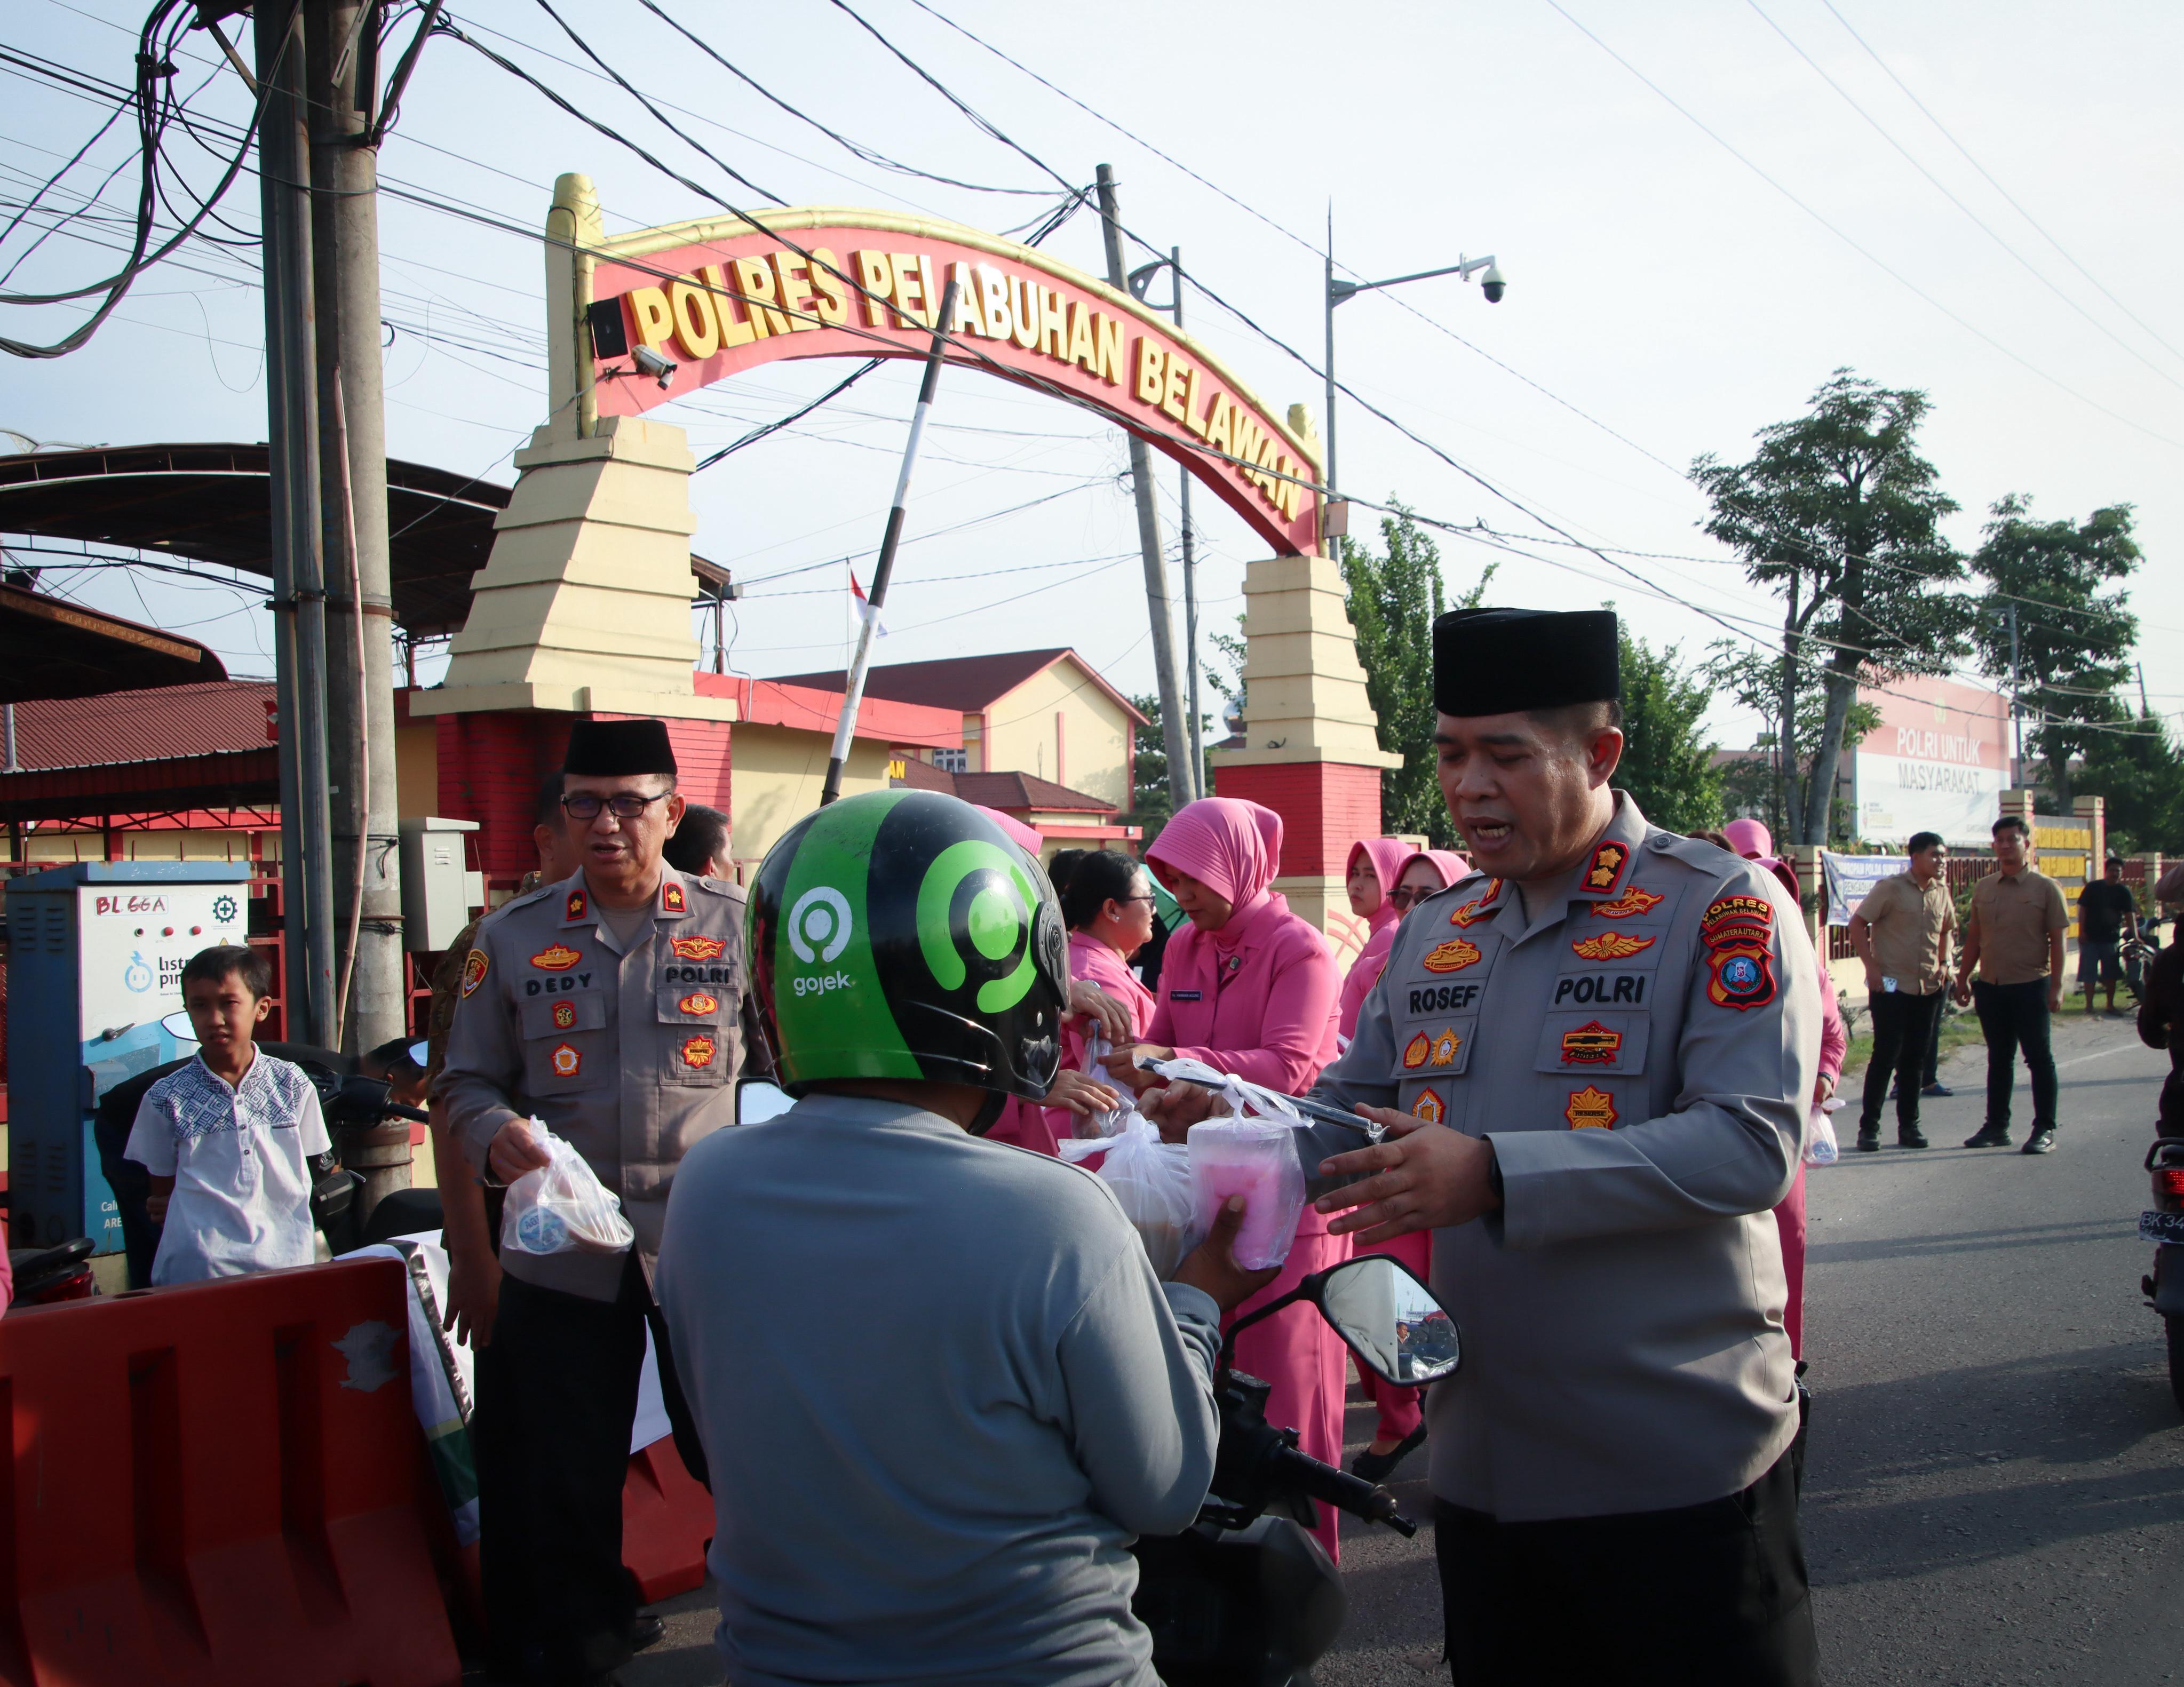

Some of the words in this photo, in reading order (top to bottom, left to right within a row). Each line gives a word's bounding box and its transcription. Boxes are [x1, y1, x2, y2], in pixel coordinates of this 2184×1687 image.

[626, 246, 849, 360] POLRES
[854, 249, 1125, 386] PELABUHAN
[1135, 336, 1305, 522] BELAWAN
[1897, 727, 1938, 760] POLRI
[1941, 733, 1981, 765] UNTUK
[1899, 762, 1980, 795] MASYARAKAT
[97, 896, 120, 916] BL
[526, 973, 591, 997] DEDY
[666, 967, 729, 983] POLRI
[793, 970, 852, 997] gojek
[1410, 985, 1479, 1014] ROSEF
[1555, 975, 1645, 1004] POLRI
[2142, 1213, 2163, 1227] BK
